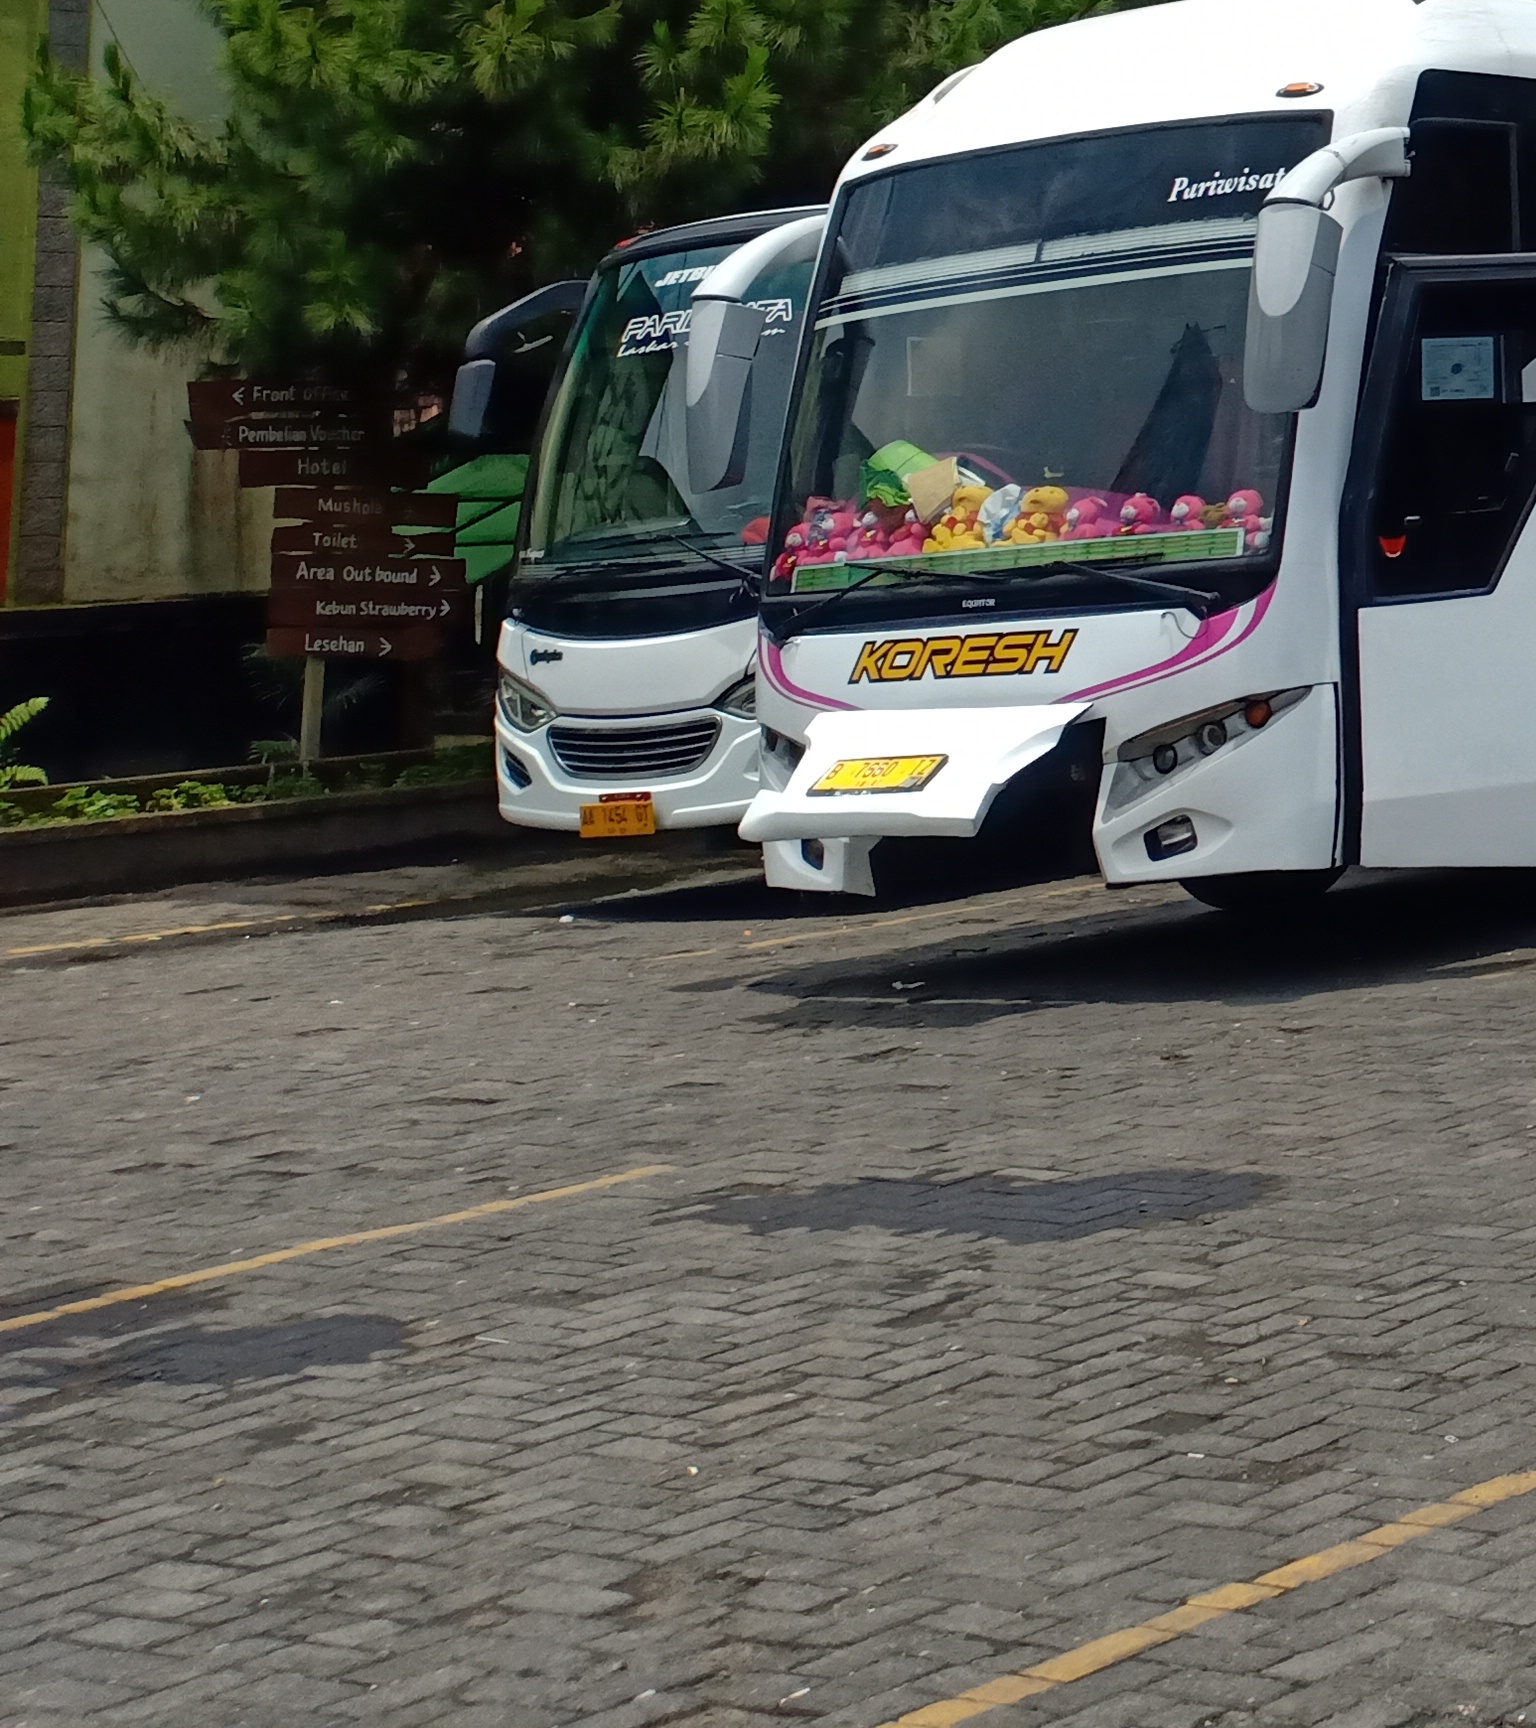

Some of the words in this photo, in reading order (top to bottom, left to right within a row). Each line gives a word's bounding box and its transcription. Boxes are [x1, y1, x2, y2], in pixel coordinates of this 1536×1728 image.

[252, 386, 296, 402] Front
[238, 425, 306, 443] Pembelian
[298, 457, 348, 475] Hotel
[312, 532, 358, 549] Toilet
[296, 561, 334, 580] Area
[316, 600, 356, 616] Kebun
[360, 601, 437, 620] Strawberry
[304, 634, 365, 653] Lesehan
[847, 628, 1080, 685] KORESH
[826, 763, 844, 780] B
